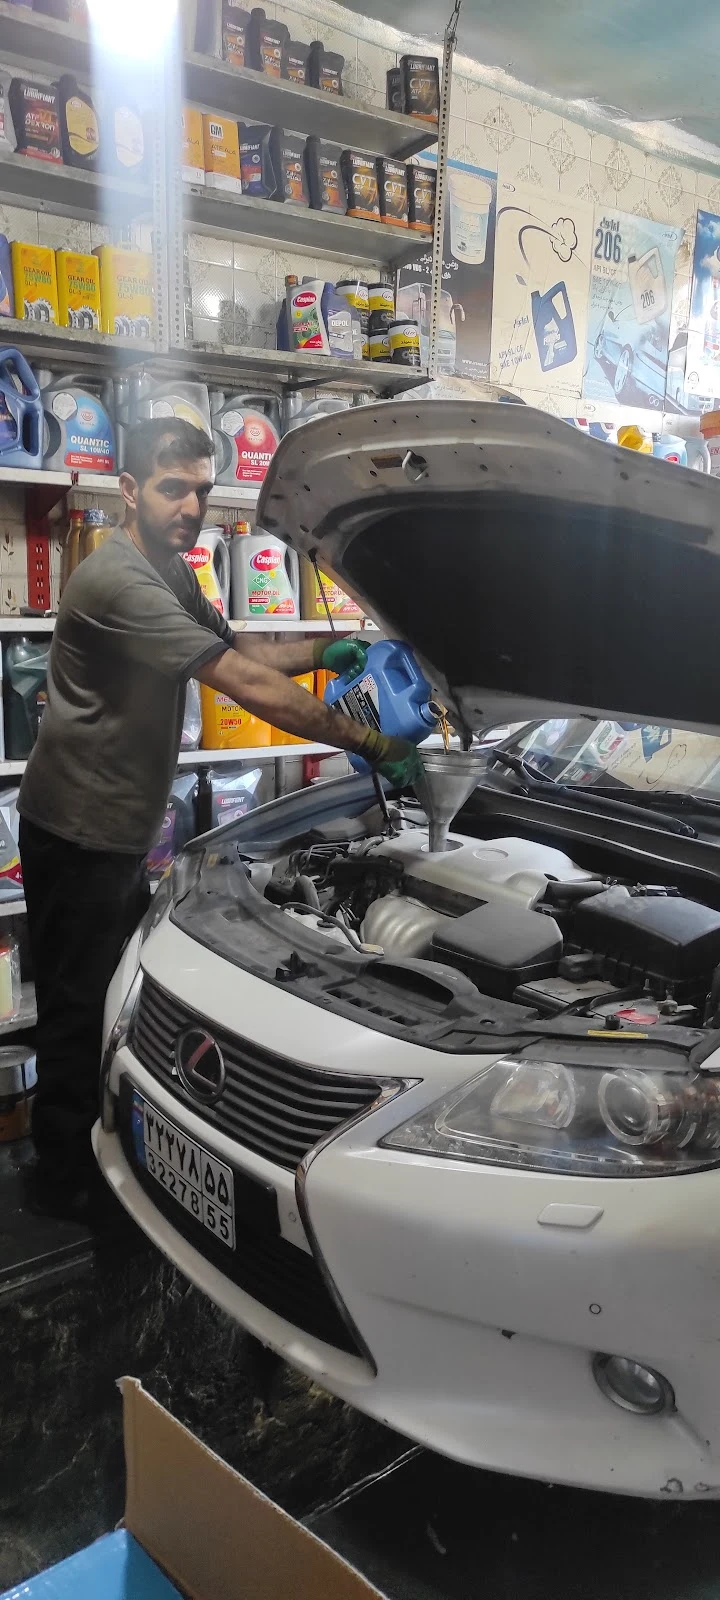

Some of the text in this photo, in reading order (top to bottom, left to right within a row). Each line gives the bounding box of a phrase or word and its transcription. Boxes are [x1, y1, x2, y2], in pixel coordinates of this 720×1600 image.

[210, 124, 223, 136] GM
[352, 173, 376, 188] CVT
[383, 180, 406, 194] CVT
[594, 228, 621, 263] 206
[69, 279, 96, 293] 75W80
[640, 290, 655, 308] 206
[70, 435, 110, 448] QUANTIC
[241, 451, 273, 460] QUANTI
[182, 552, 209, 564] Caspian
[256, 554, 280, 566] Caspian
[220, 718, 242, 726] 20W50
[145, 1111, 229, 1207] ۳۲۲۷۸ ۵۵
[148, 1151, 229, 1241] 32278 55
